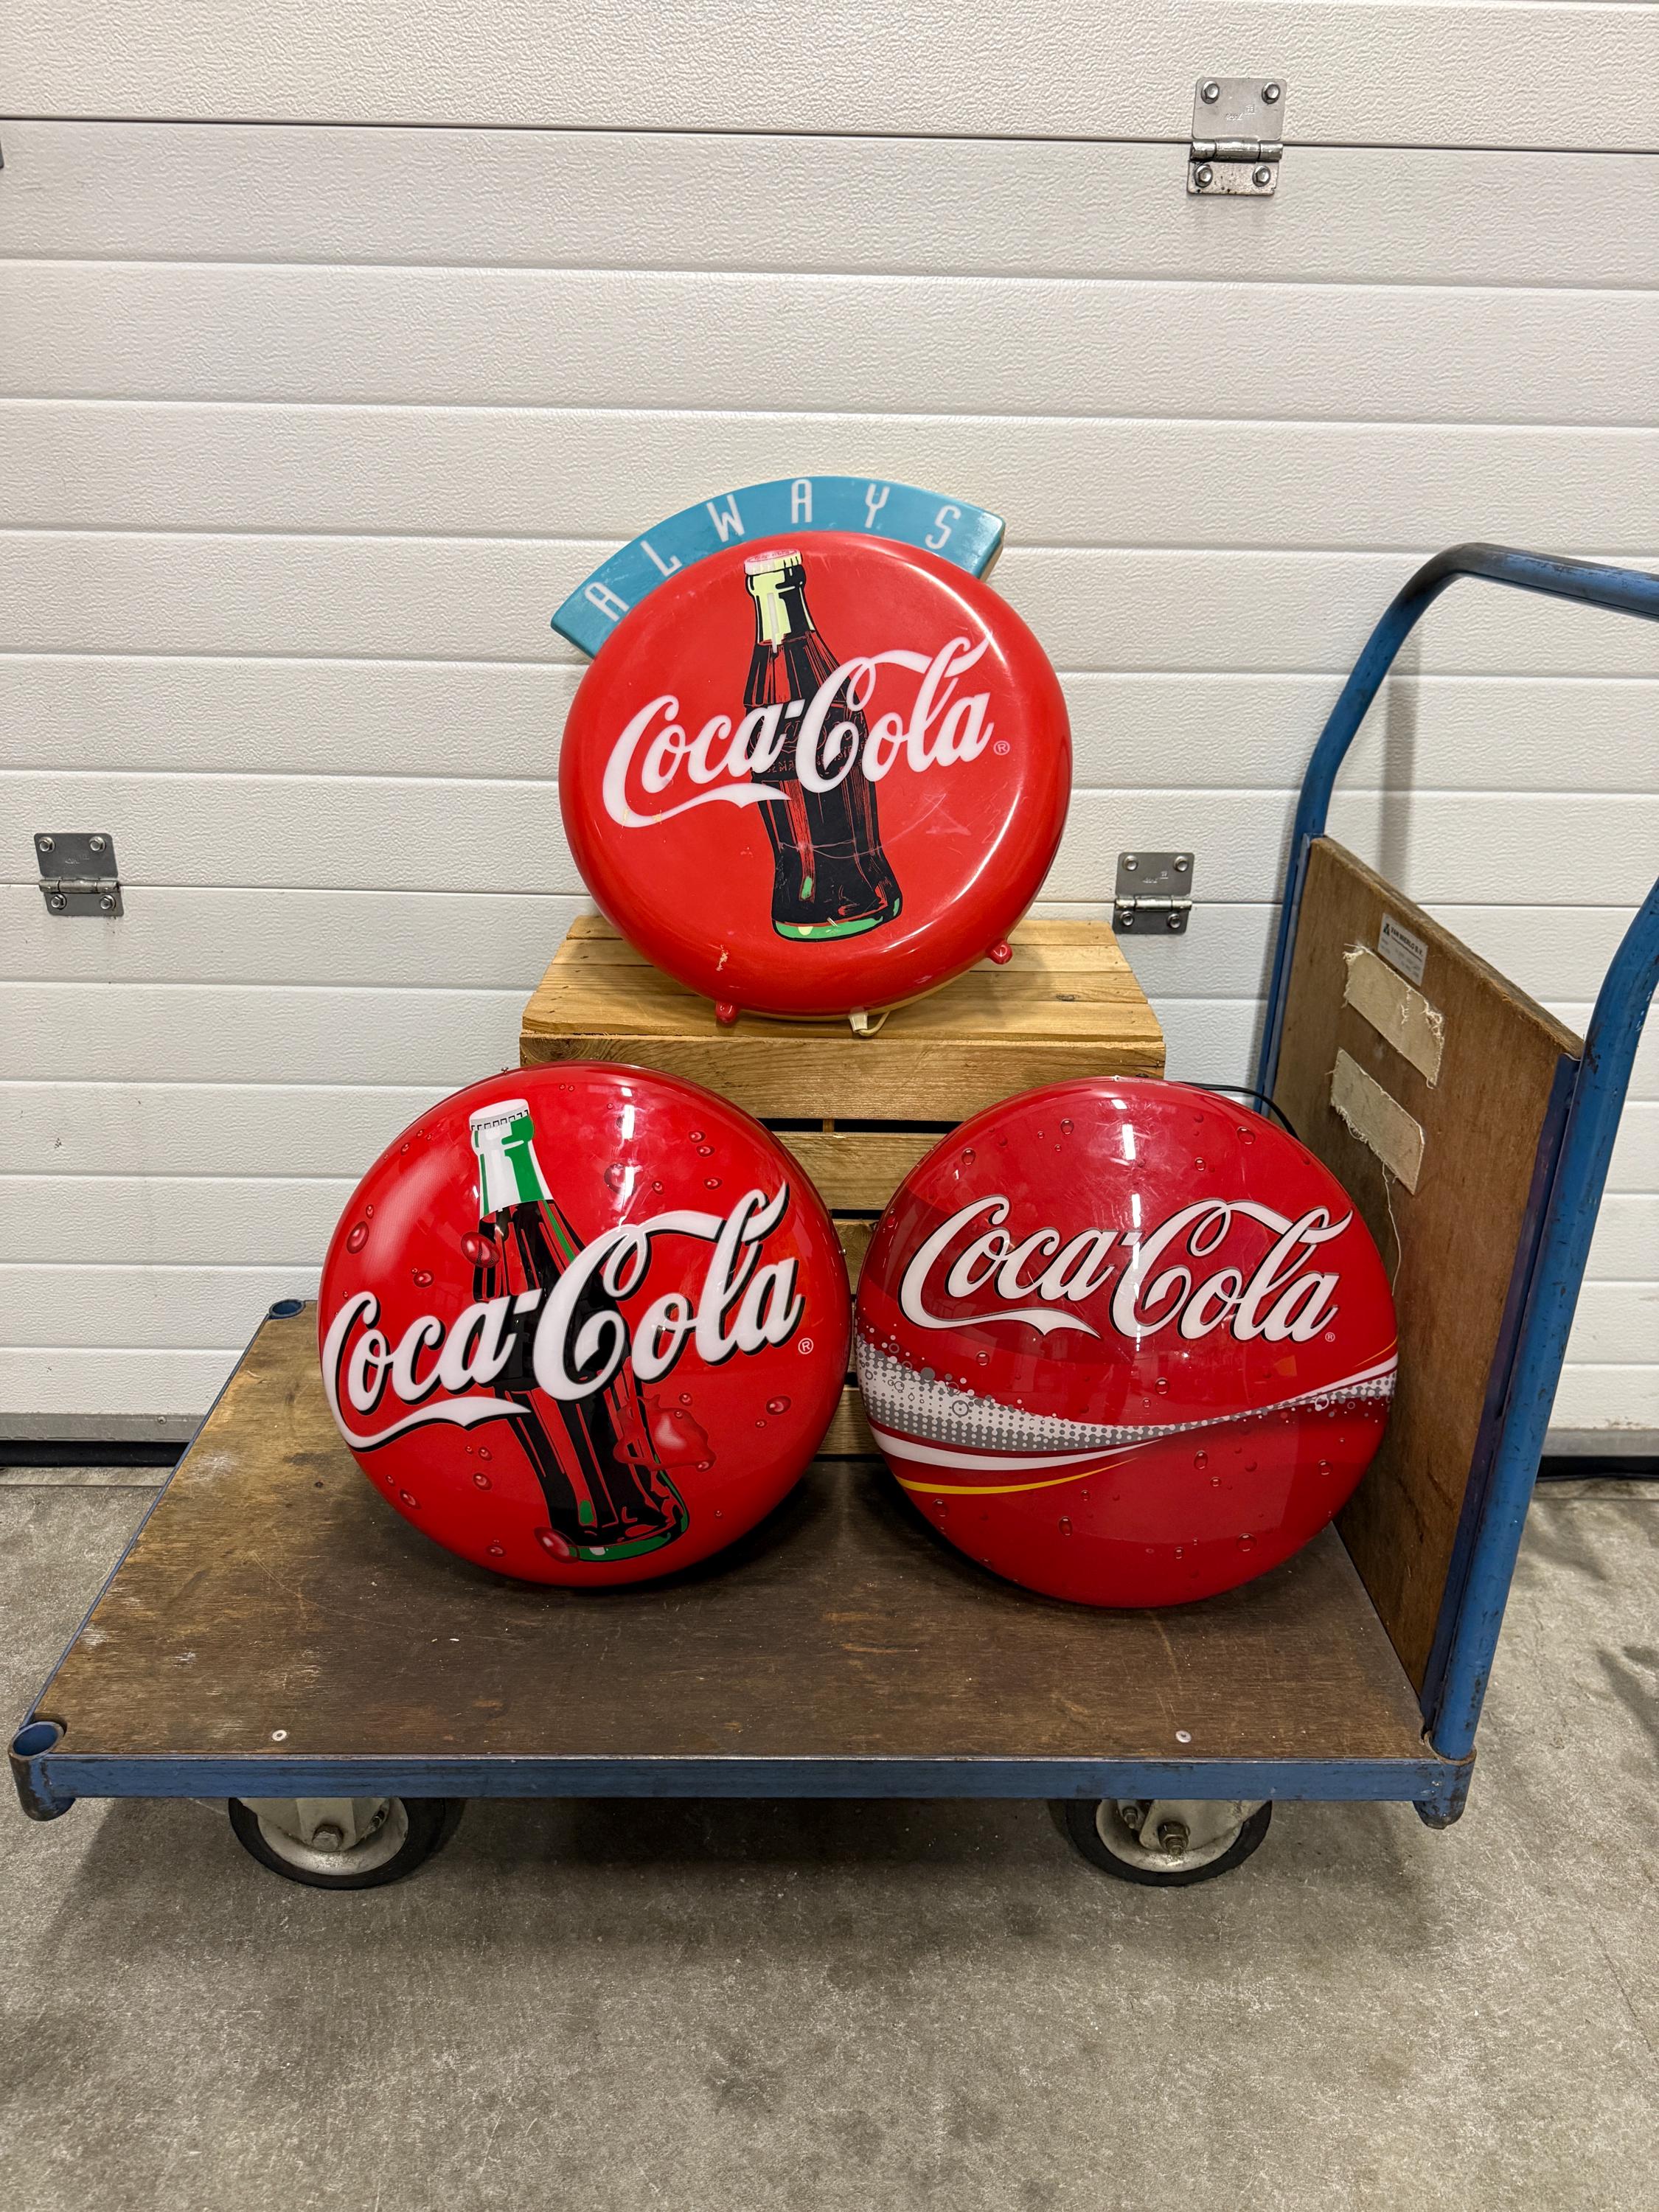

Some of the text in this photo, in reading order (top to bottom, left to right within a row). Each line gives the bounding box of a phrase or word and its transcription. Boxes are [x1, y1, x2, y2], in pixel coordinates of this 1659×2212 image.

[584, 478, 962, 623] ALWAYS
[602, 630, 995, 828] Coca-Cola
[321, 1180, 807, 1453] Coca-Cola
[897, 1194, 1354, 1343] Coca-Cola
